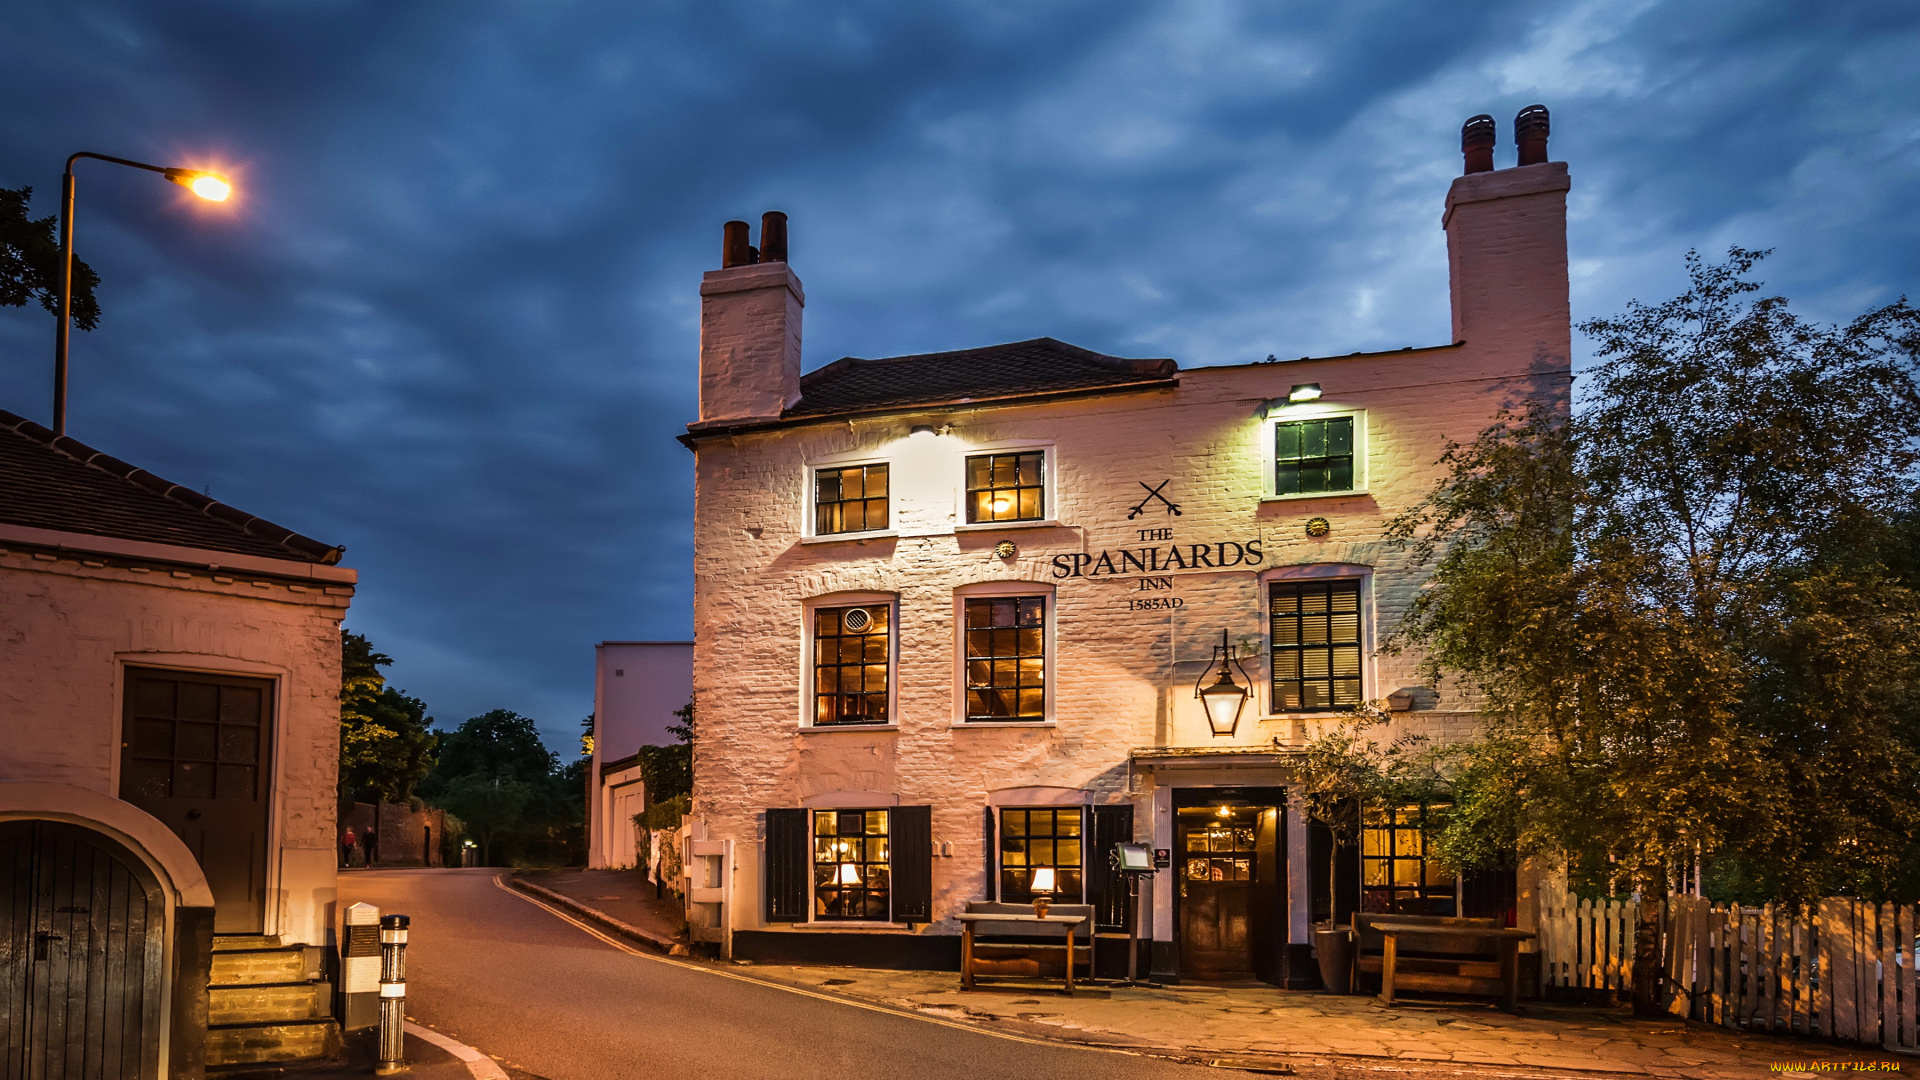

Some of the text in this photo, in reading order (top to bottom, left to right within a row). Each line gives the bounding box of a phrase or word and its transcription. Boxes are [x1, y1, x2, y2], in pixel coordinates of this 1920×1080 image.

[1137, 528, 1174, 542] THE
[1052, 540, 1263, 579] SPANIARDS
[1138, 577, 1173, 591] INN
[1129, 597, 1184, 611] 1585AD
